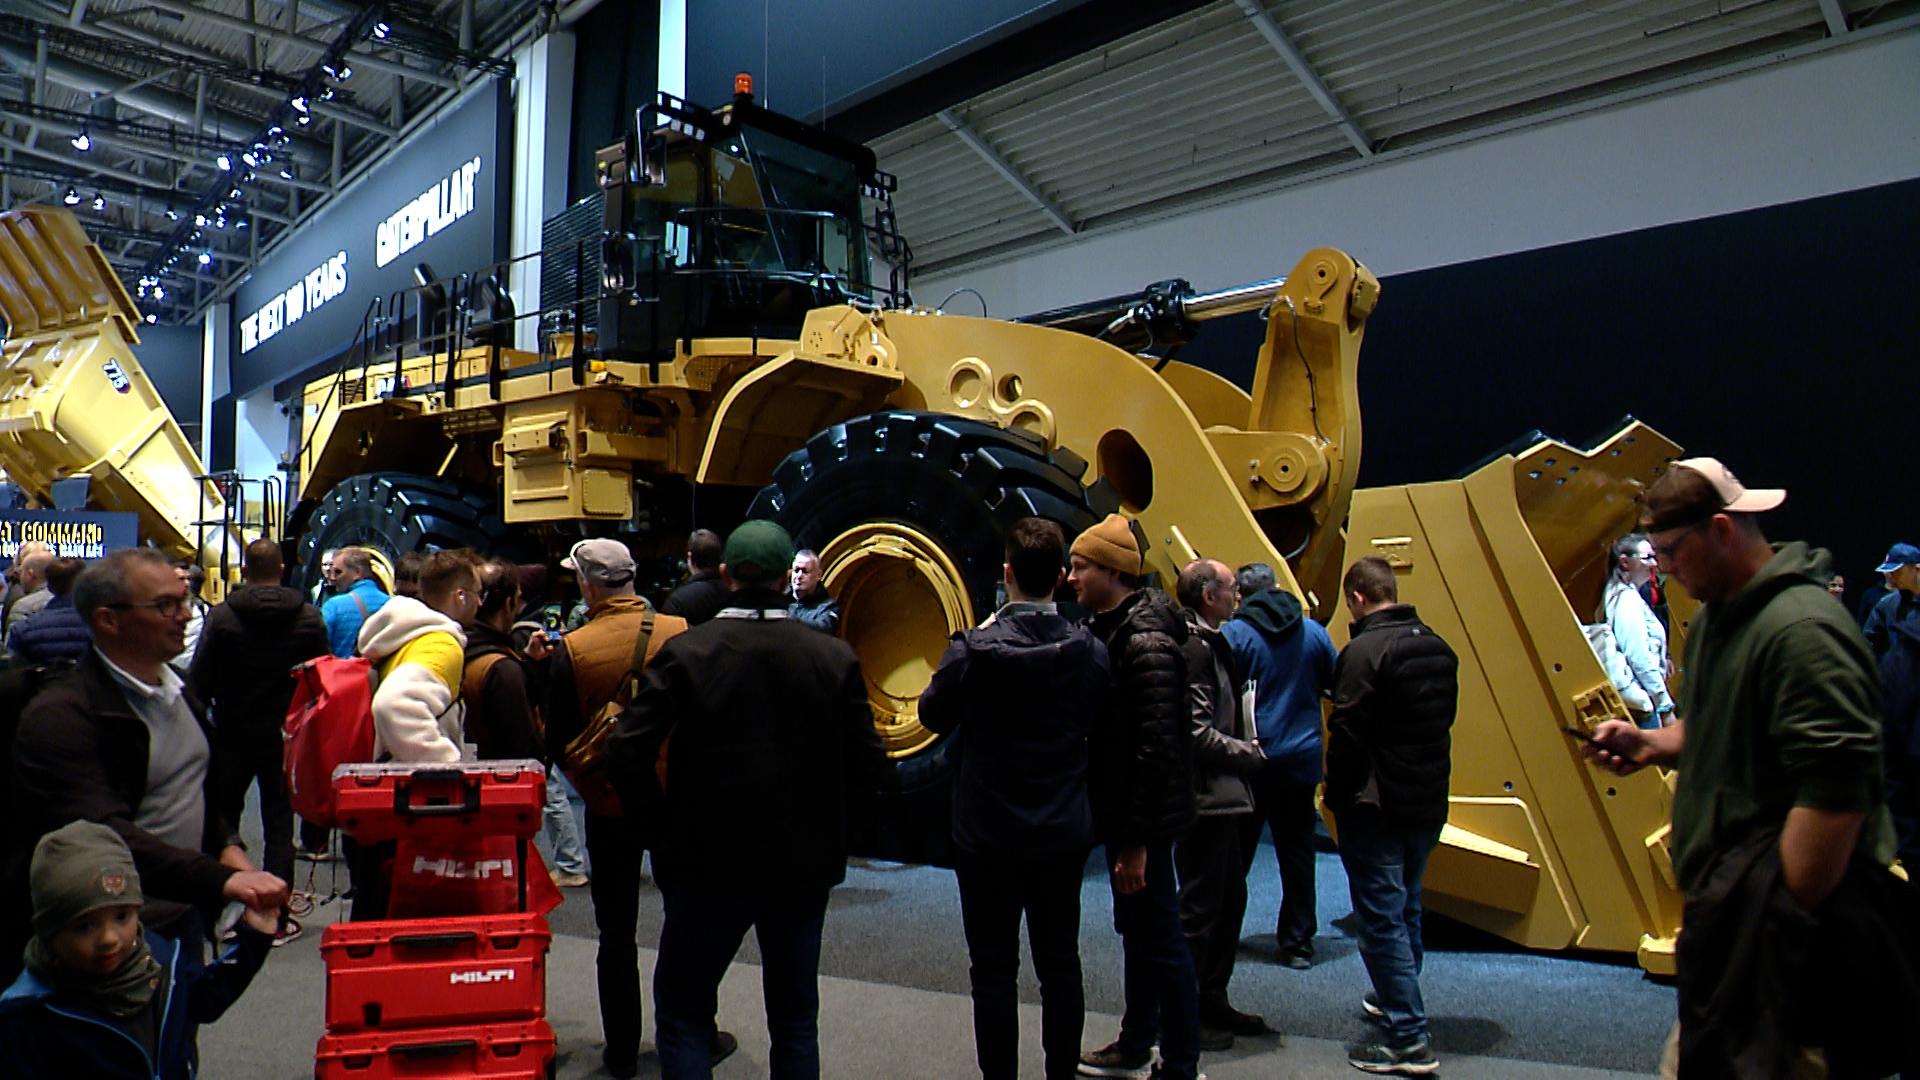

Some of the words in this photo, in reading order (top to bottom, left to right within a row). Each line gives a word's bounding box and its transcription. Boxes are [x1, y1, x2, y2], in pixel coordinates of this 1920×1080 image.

[240, 311, 259, 354] THE
[258, 293, 286, 344] NEXT
[305, 250, 347, 312] YEARS
[413, 856, 513, 879] HILTI
[450, 968, 515, 984] HILTI
